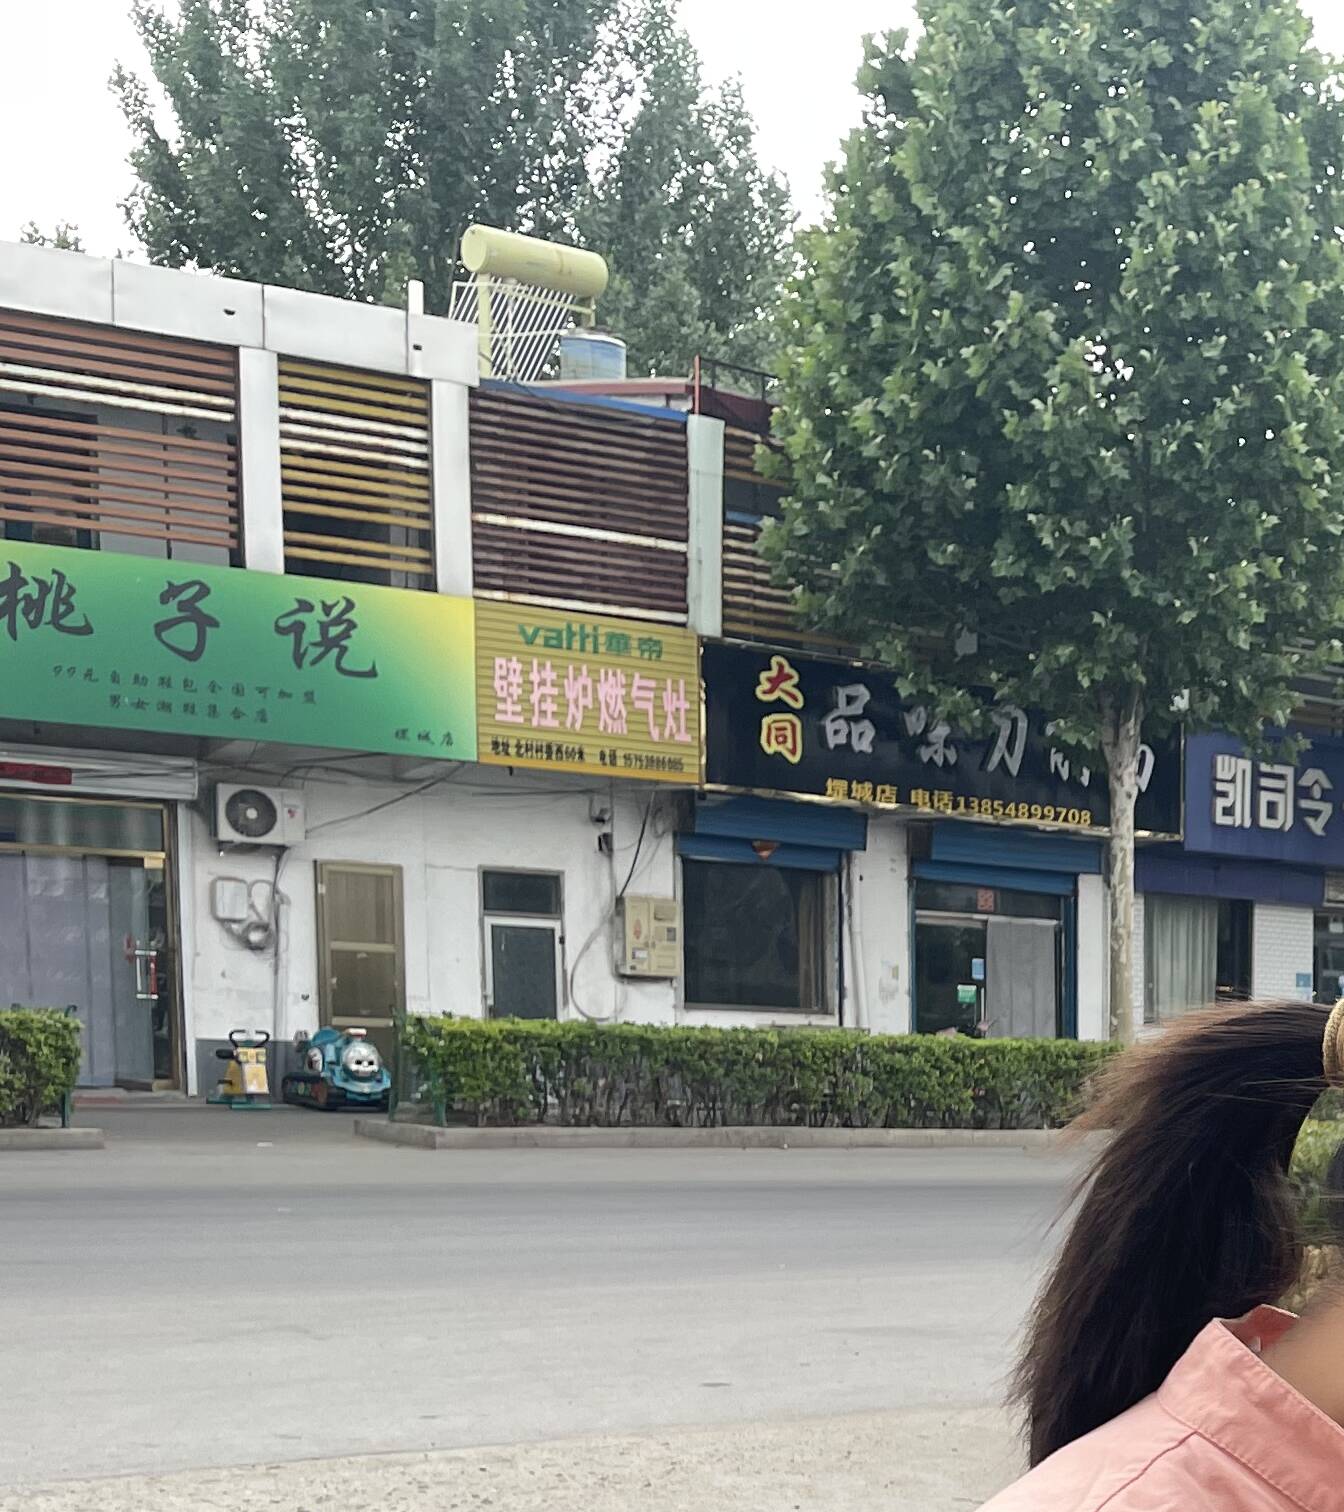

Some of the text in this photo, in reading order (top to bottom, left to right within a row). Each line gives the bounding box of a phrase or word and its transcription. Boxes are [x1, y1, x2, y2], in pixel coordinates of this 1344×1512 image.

[0, 561, 378, 678] 桃子说
[494, 656, 692, 742] 壁挂炉燃气灶
[756, 655, 804, 764] 大同
